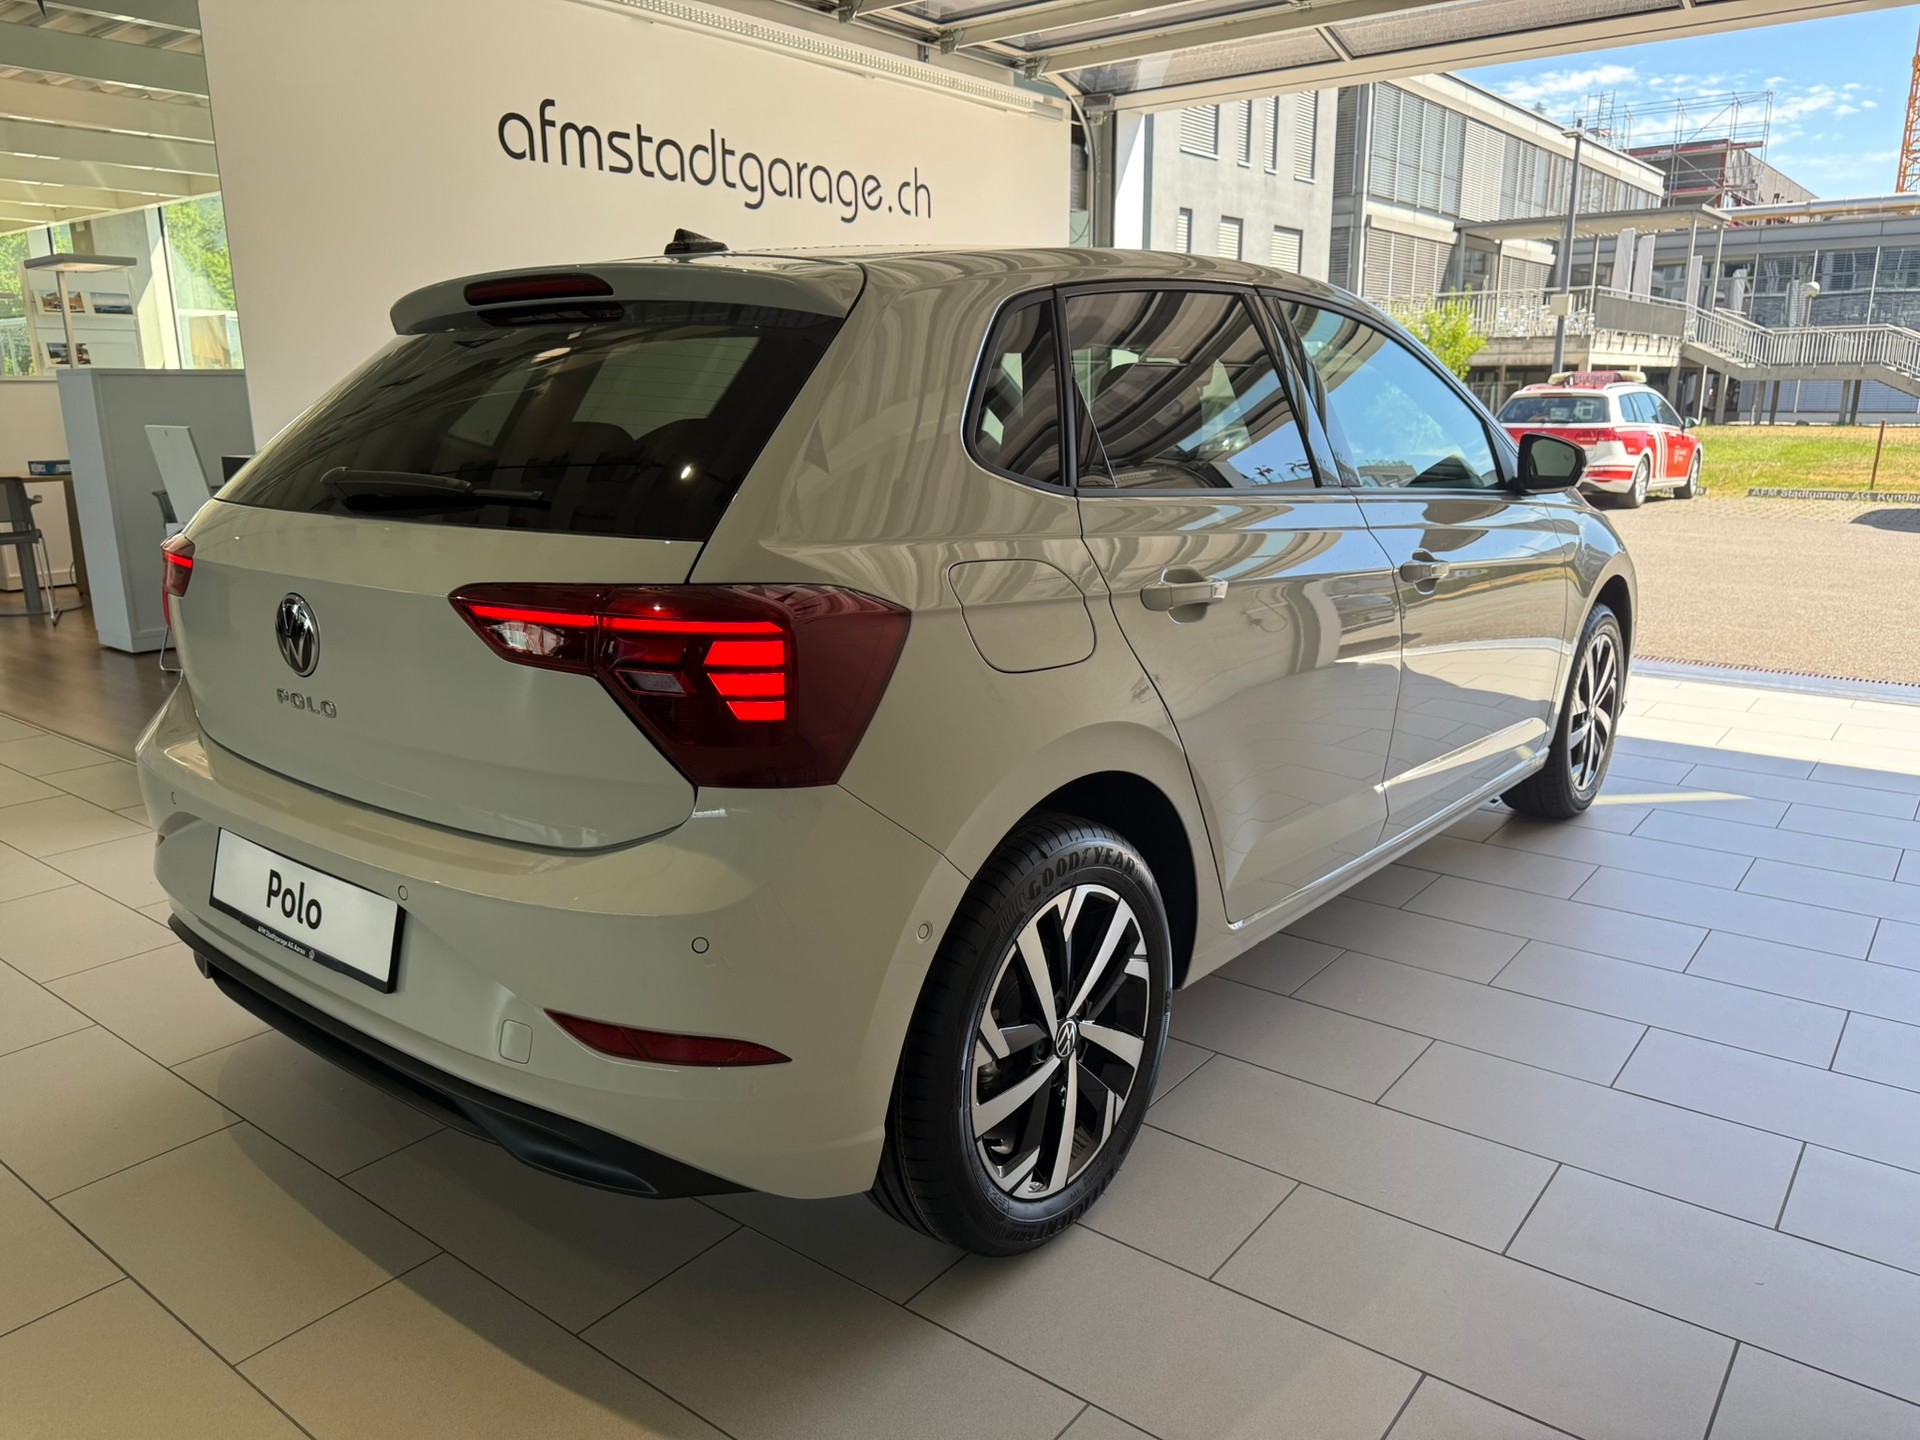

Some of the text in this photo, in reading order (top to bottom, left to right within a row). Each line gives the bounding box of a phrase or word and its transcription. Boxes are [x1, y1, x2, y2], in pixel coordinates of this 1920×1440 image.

[498, 98, 931, 223] afmstadtgarage.ch
[1751, 488, 1778, 497] AFM
[1780, 489, 1849, 500] Stadtgarage
[1851, 491, 1871, 500] AG
[276, 688, 337, 719] POLO
[266, 868, 322, 930] Polo
[1028, 846, 1137, 900] GOODYEAR
